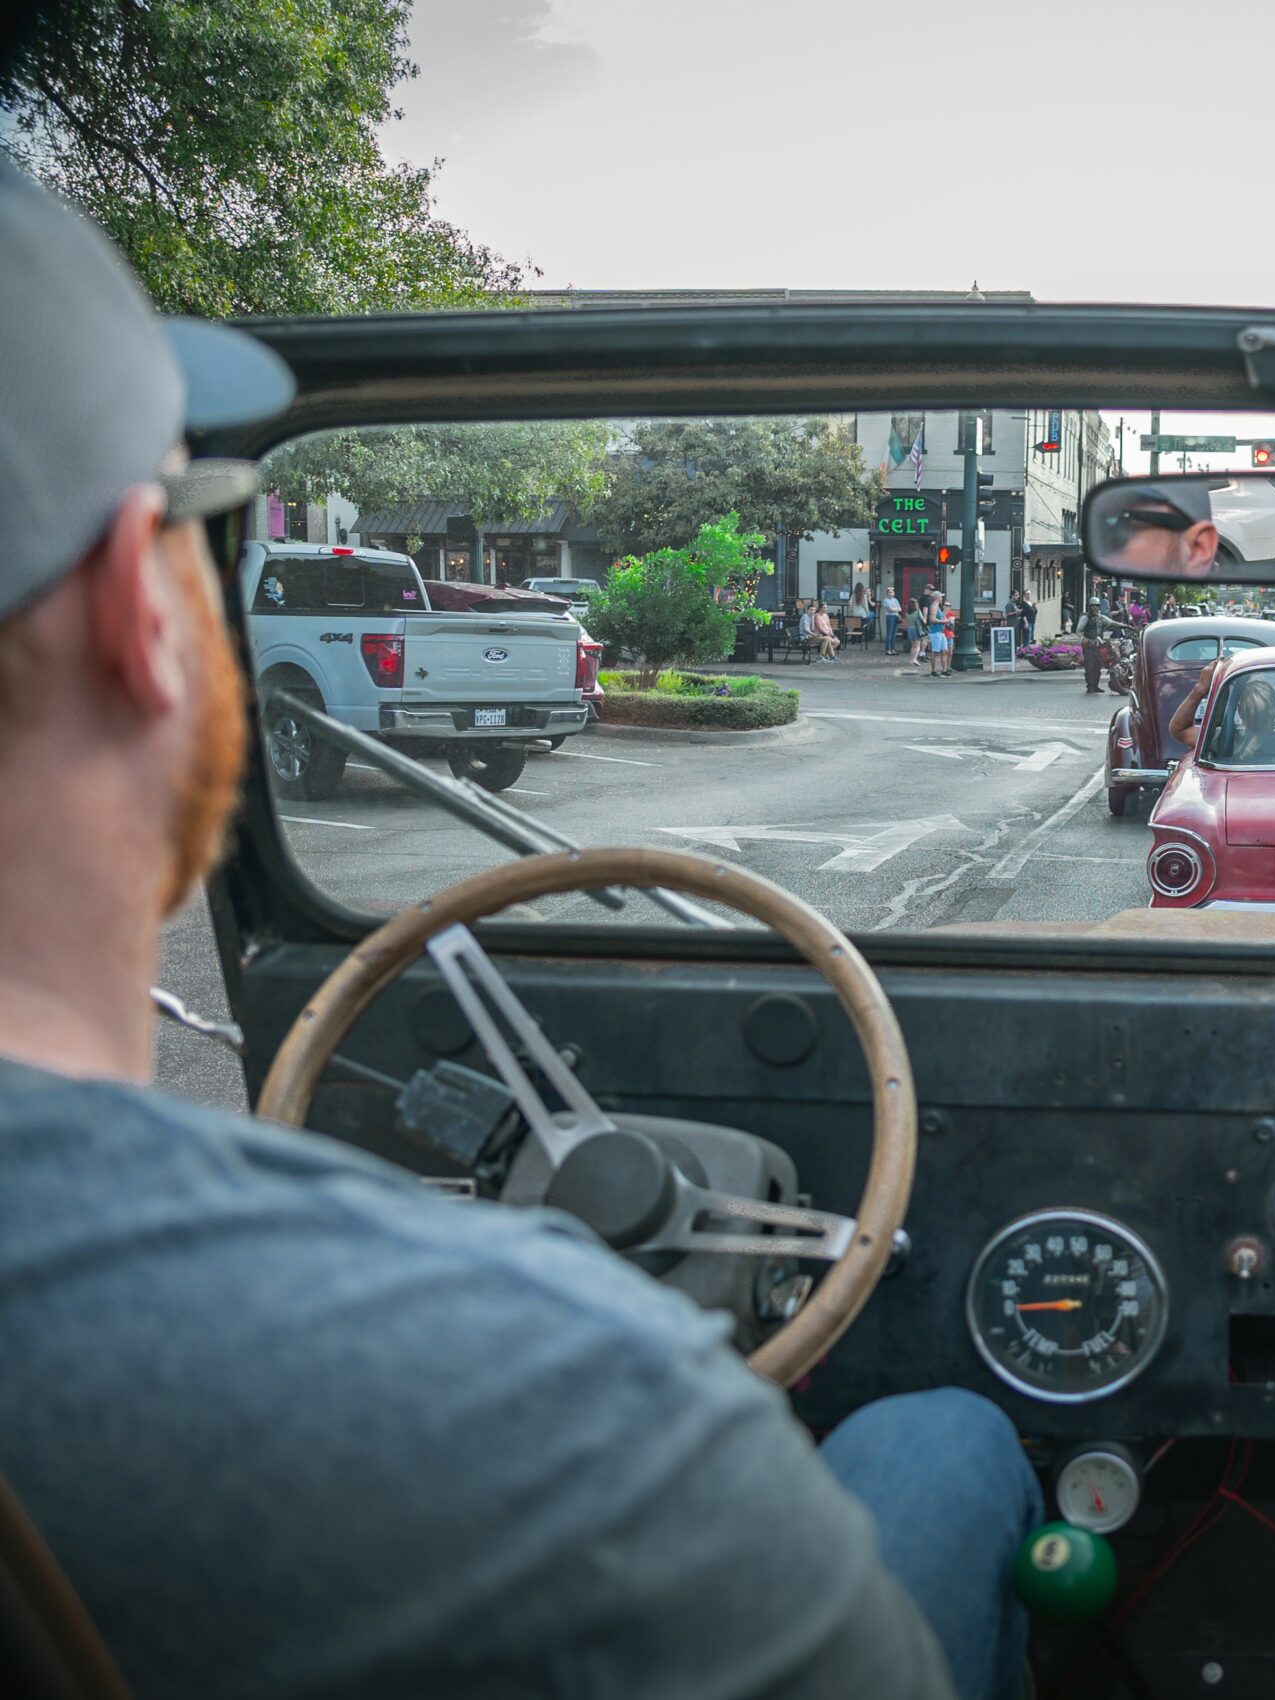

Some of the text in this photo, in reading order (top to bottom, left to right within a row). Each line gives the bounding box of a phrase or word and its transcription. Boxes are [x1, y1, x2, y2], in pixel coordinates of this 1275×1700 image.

[893, 498, 926, 511] THE
[878, 518, 929, 533] CELT
[487, 649, 504, 660] Ford
[1046, 1236, 1064, 1252] 40
[1070, 1236, 1088, 1252] 50
[1024, 1243, 1041, 1263] 30
[1007, 1258, 1025, 1277] 20
[1001, 1279, 1017, 1297] 10
[1081, 1331, 1116, 1357] FUEL
